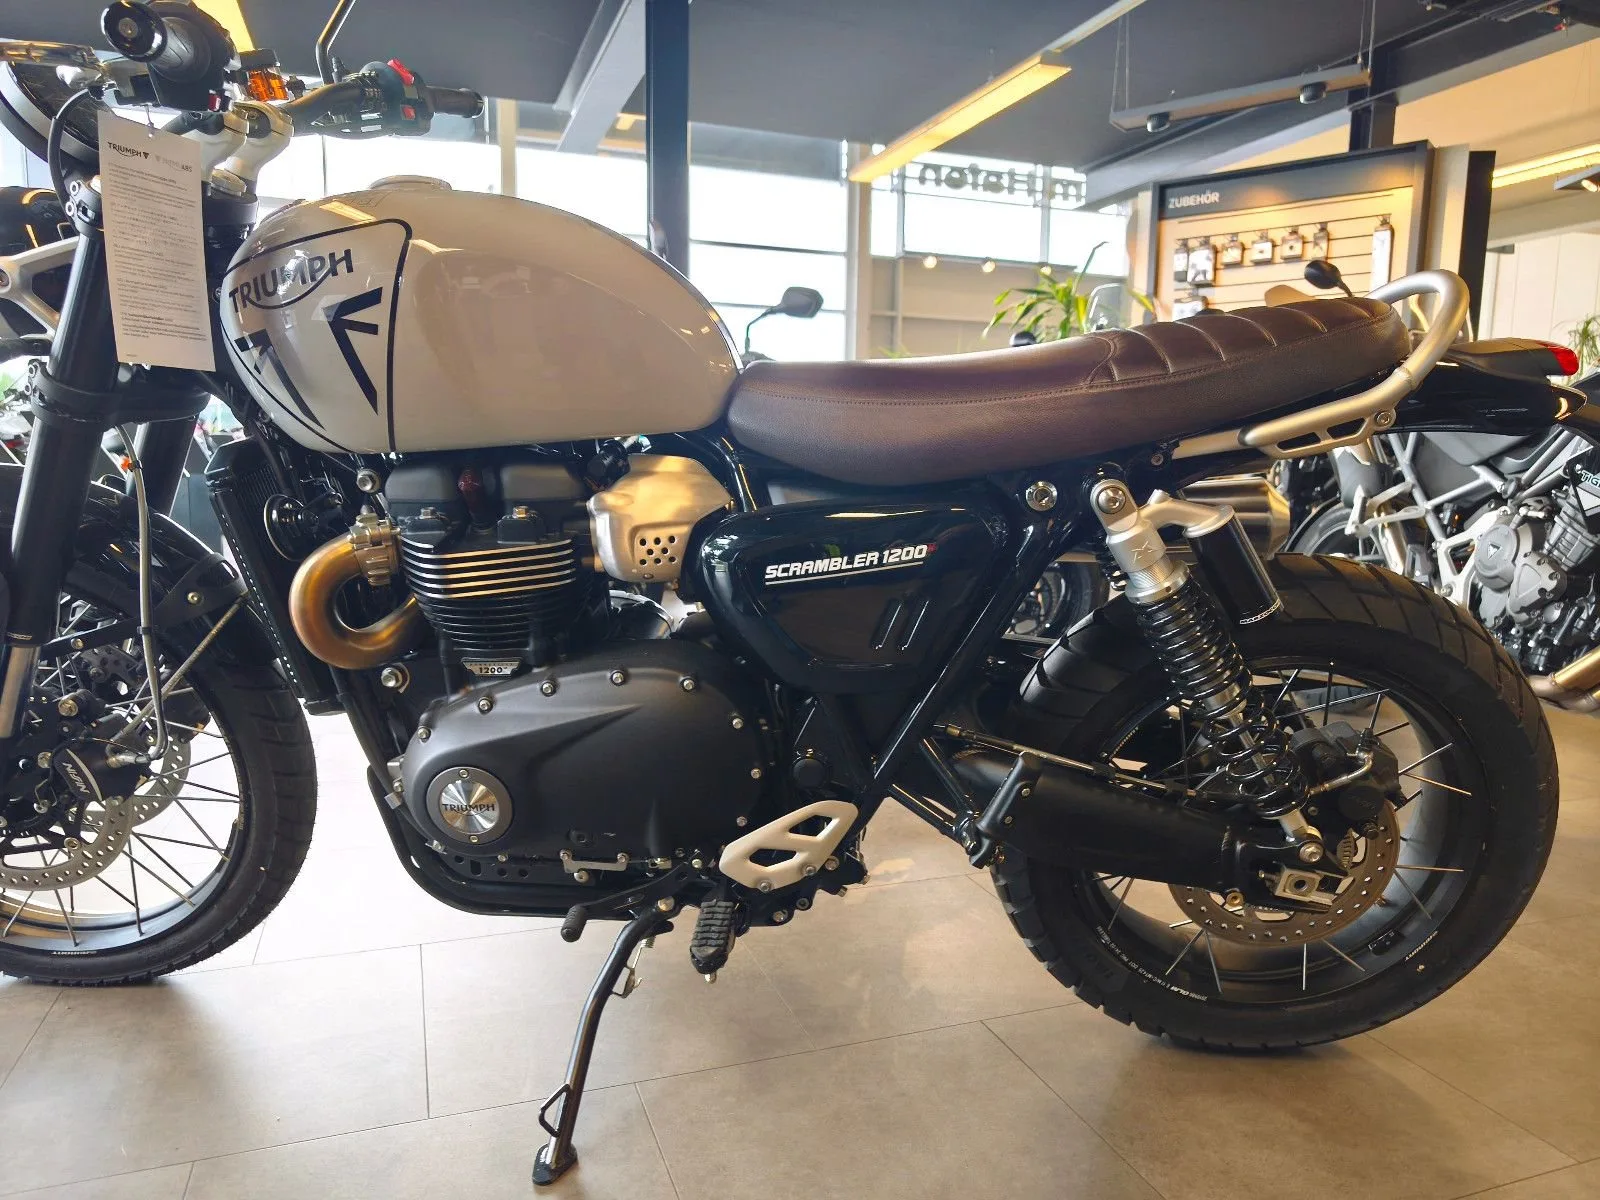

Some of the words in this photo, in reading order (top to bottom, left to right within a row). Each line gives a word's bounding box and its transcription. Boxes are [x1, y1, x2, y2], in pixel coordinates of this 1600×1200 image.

[107, 141, 142, 157] TRIUMPH
[1167, 189, 1220, 209] ZUBEHÖR
[228, 248, 354, 313] TRIUMPH
[1580, 469, 1600, 489] TIG
[764, 551, 880, 579] SCRAMBLER
[478, 666, 503, 674] 1200
[62, 762, 91, 794] NISSIN
[441, 803, 495, 814] TRIUMPH
